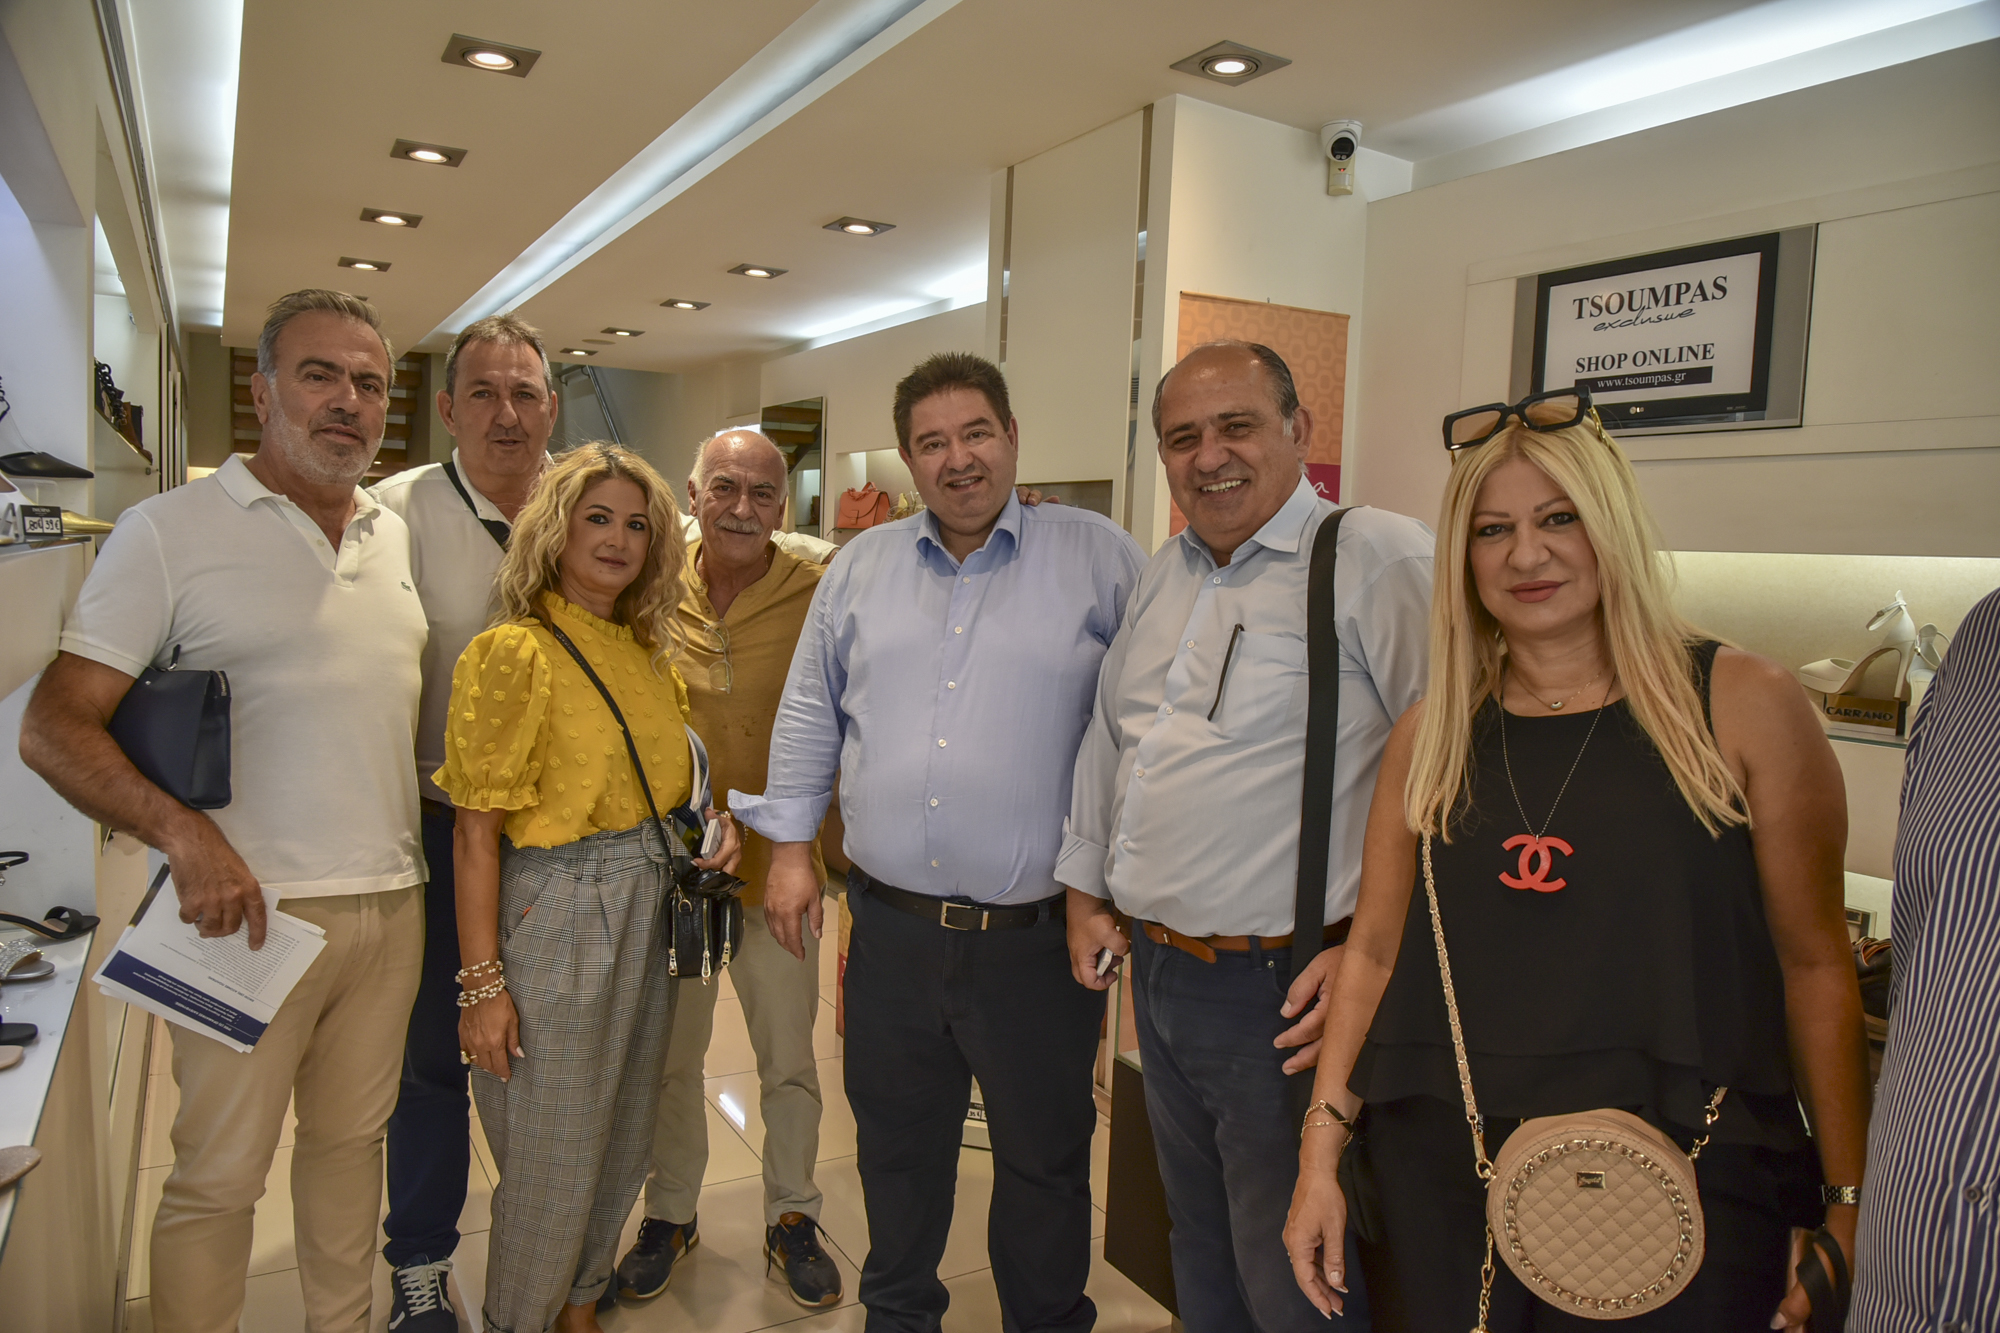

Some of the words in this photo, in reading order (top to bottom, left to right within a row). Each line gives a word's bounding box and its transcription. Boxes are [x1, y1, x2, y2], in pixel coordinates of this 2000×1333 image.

[1573, 275, 1728, 320] TSOUMPAS
[1575, 351, 1628, 374] SHOP
[1632, 342, 1715, 368] ONLINE
[1597, 371, 1687, 389] www.tsoumpas.gr
[1826, 706, 1894, 722] CARRANO
